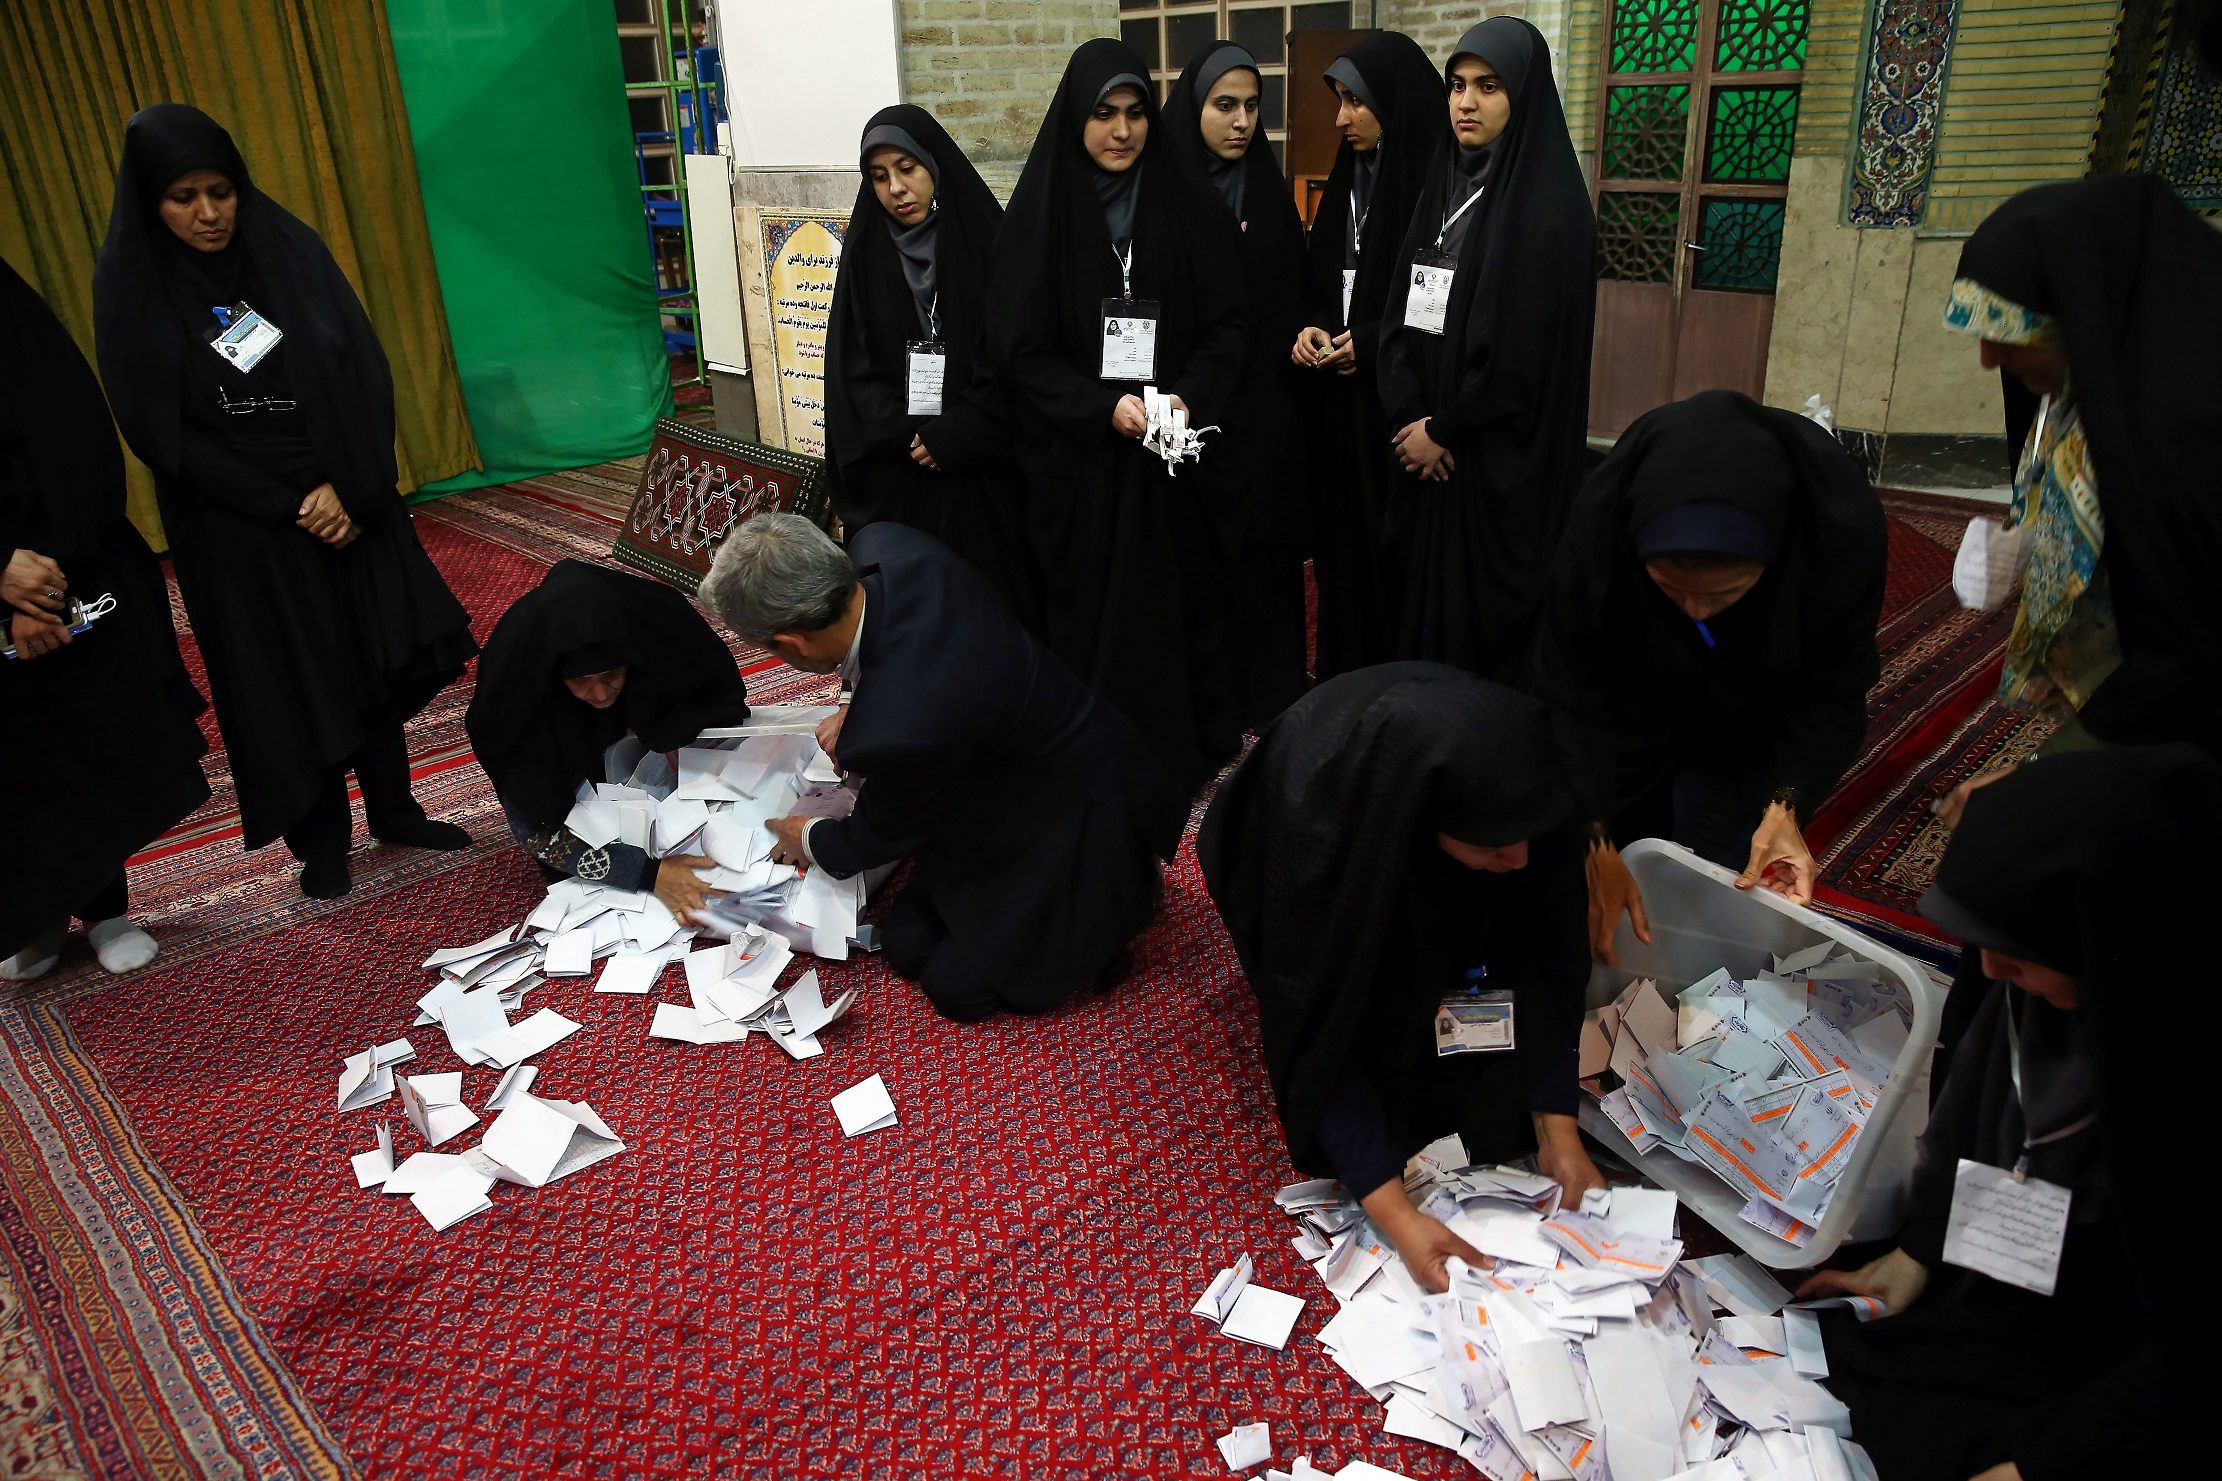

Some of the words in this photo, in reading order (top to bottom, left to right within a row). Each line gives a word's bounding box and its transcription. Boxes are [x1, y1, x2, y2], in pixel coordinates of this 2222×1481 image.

[788, 253, 805, 266] والدین
[805, 254, 818, 267] برای
[819, 254, 833, 268] فرزند
[810, 283, 825, 292] الرحمن
